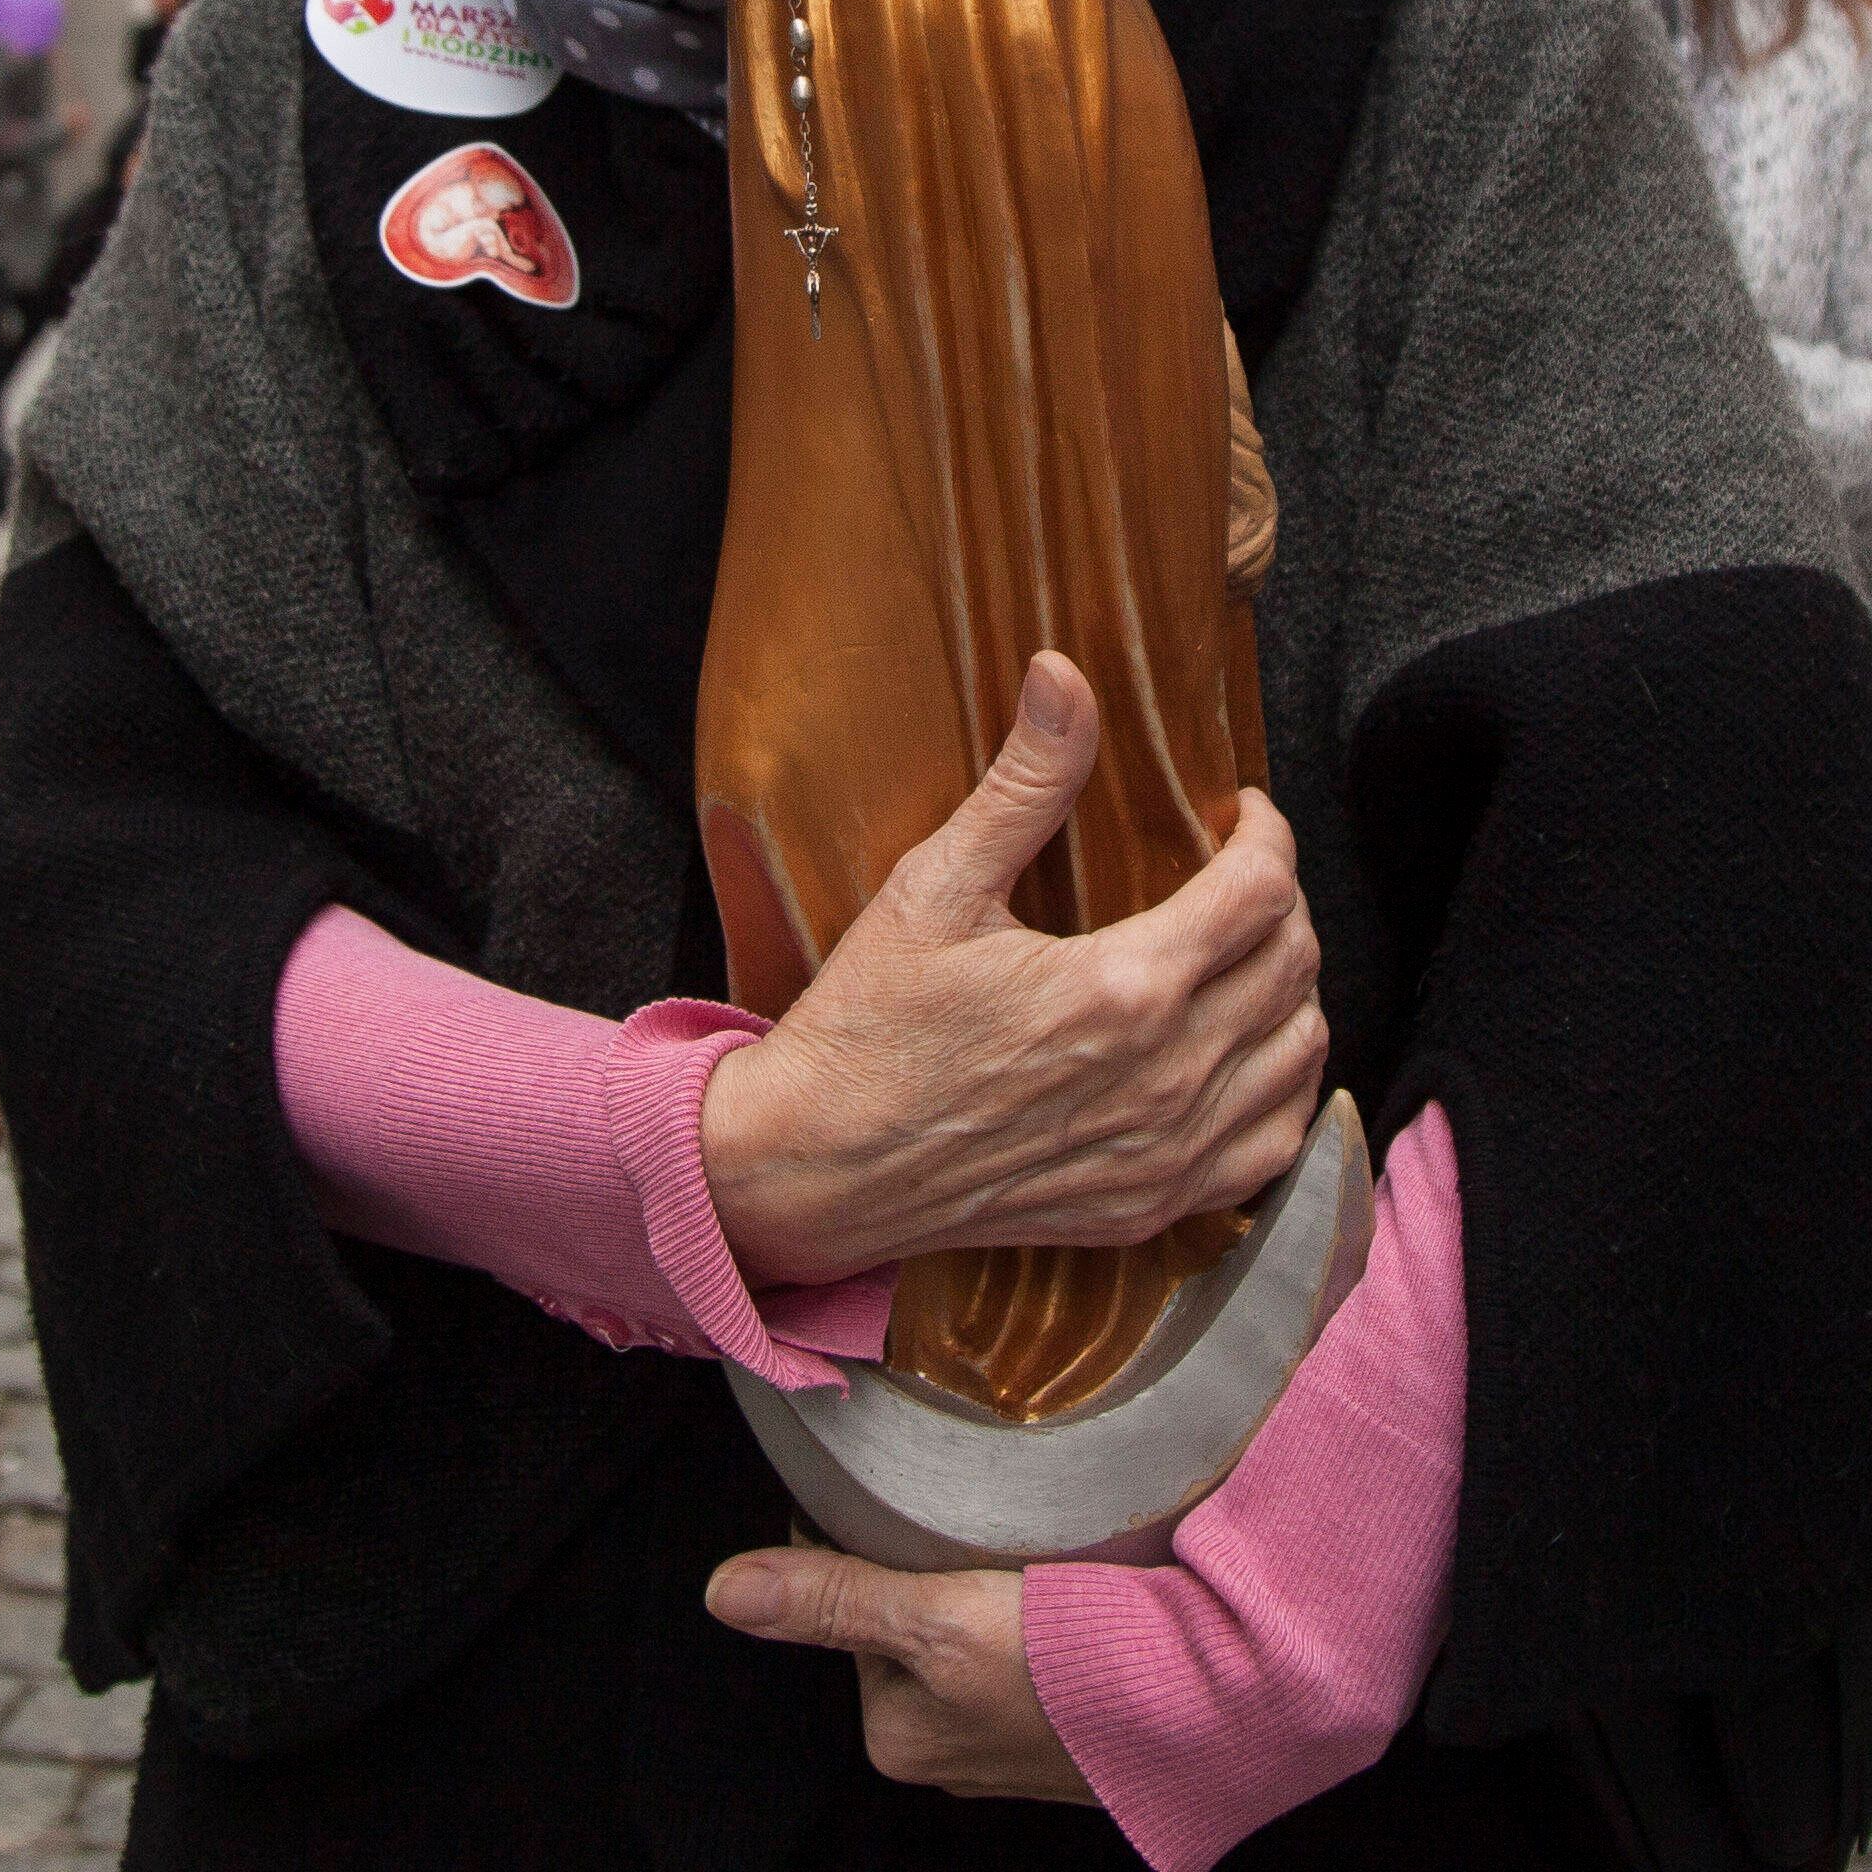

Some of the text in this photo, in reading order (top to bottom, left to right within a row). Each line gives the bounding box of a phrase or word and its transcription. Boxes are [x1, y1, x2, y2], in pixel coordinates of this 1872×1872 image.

[411, 0, 515, 29] MARSZ
[416, 15, 465, 37] DLA
[402, 27, 554, 69] I RODZINY
